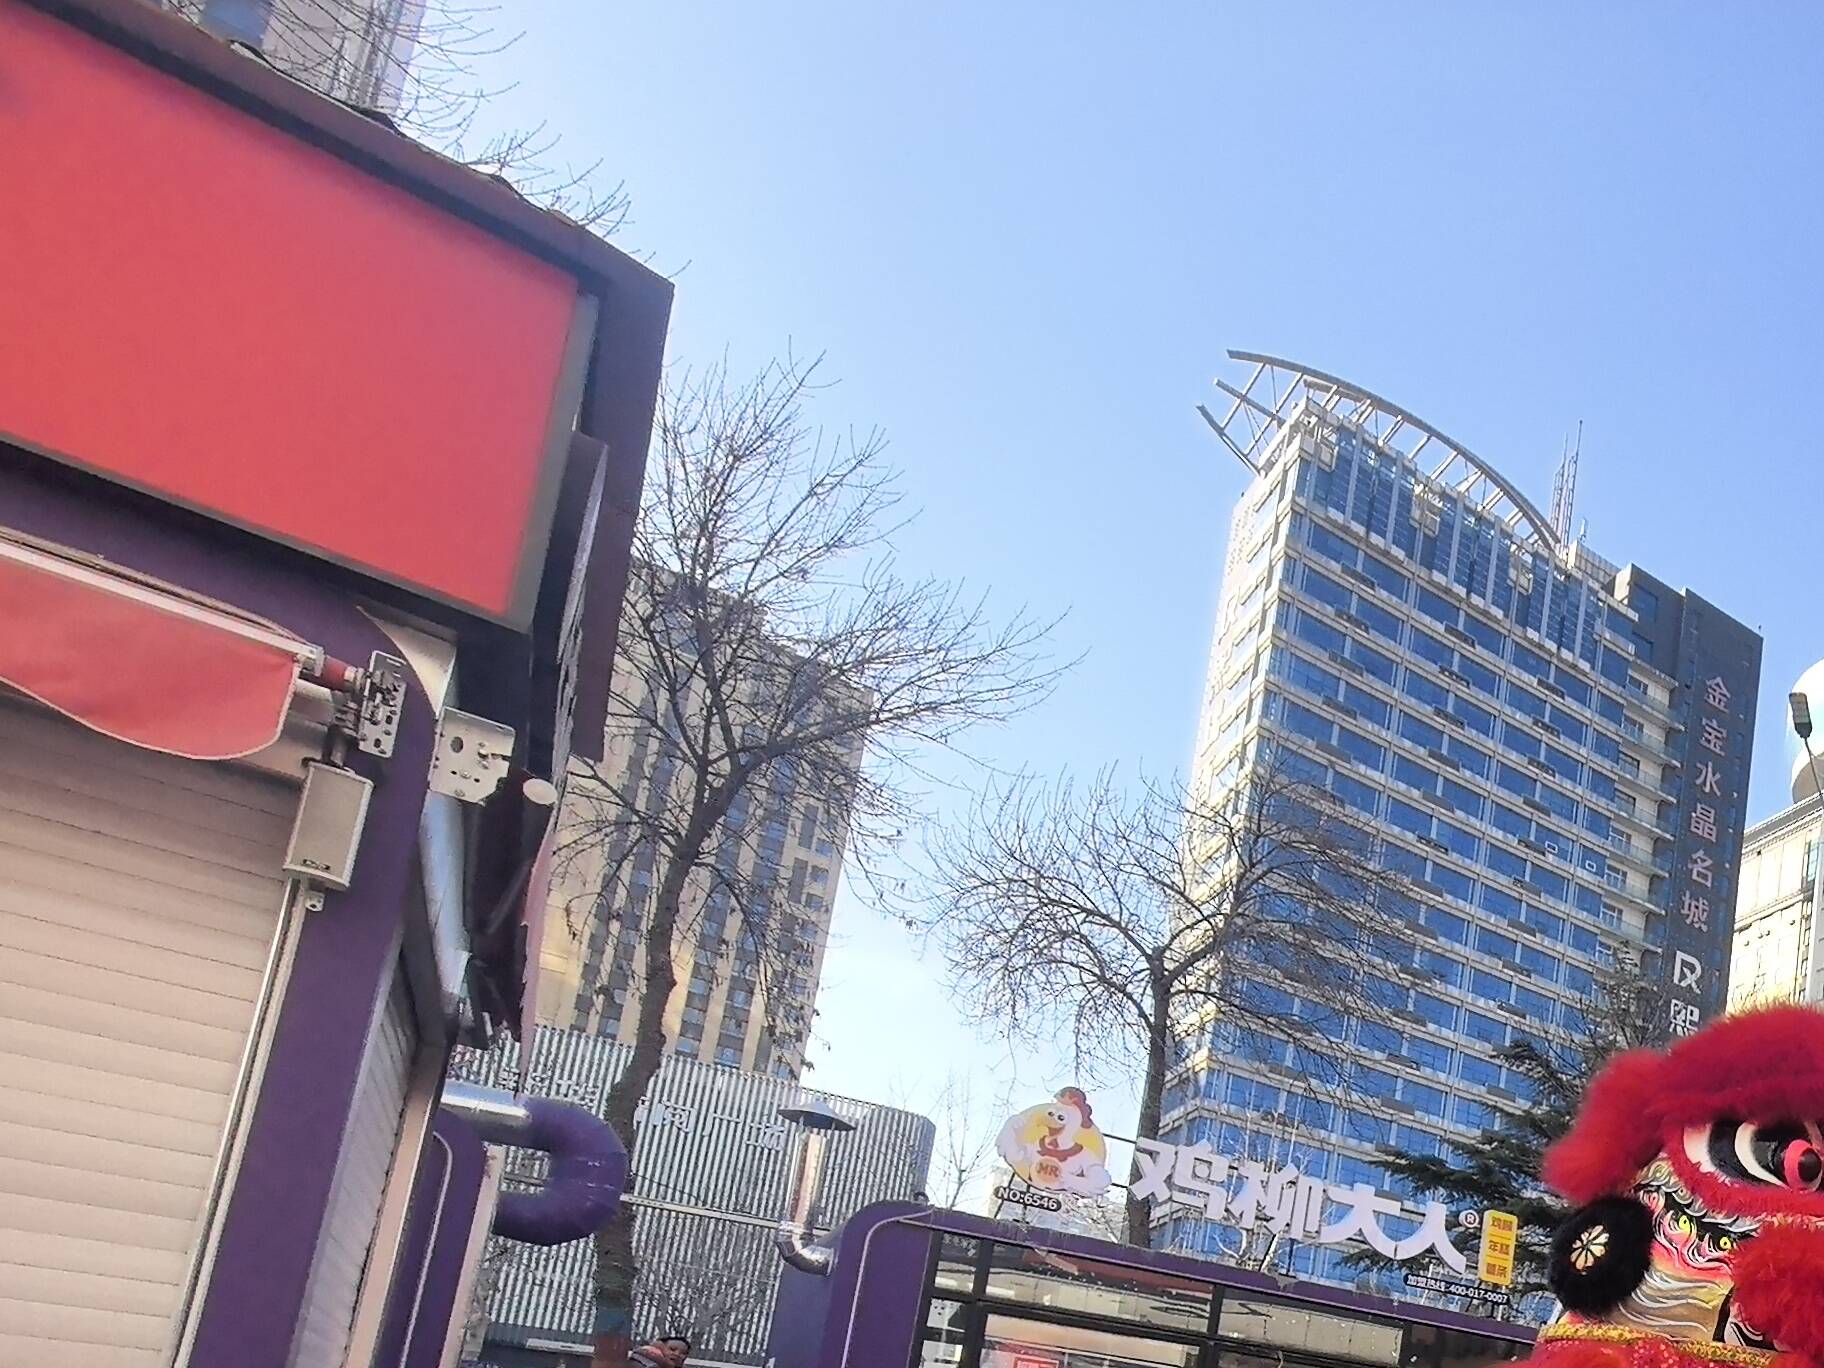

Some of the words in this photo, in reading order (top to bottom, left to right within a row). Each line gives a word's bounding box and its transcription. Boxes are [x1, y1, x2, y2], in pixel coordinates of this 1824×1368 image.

[1681, 676, 1731, 932] 金宝水晶名城
[998, 1187, 1058, 1210] NO:6546
[1035, 1162, 1059, 1178] MR
[1130, 1137, 1467, 1275] 鸡柳大人
